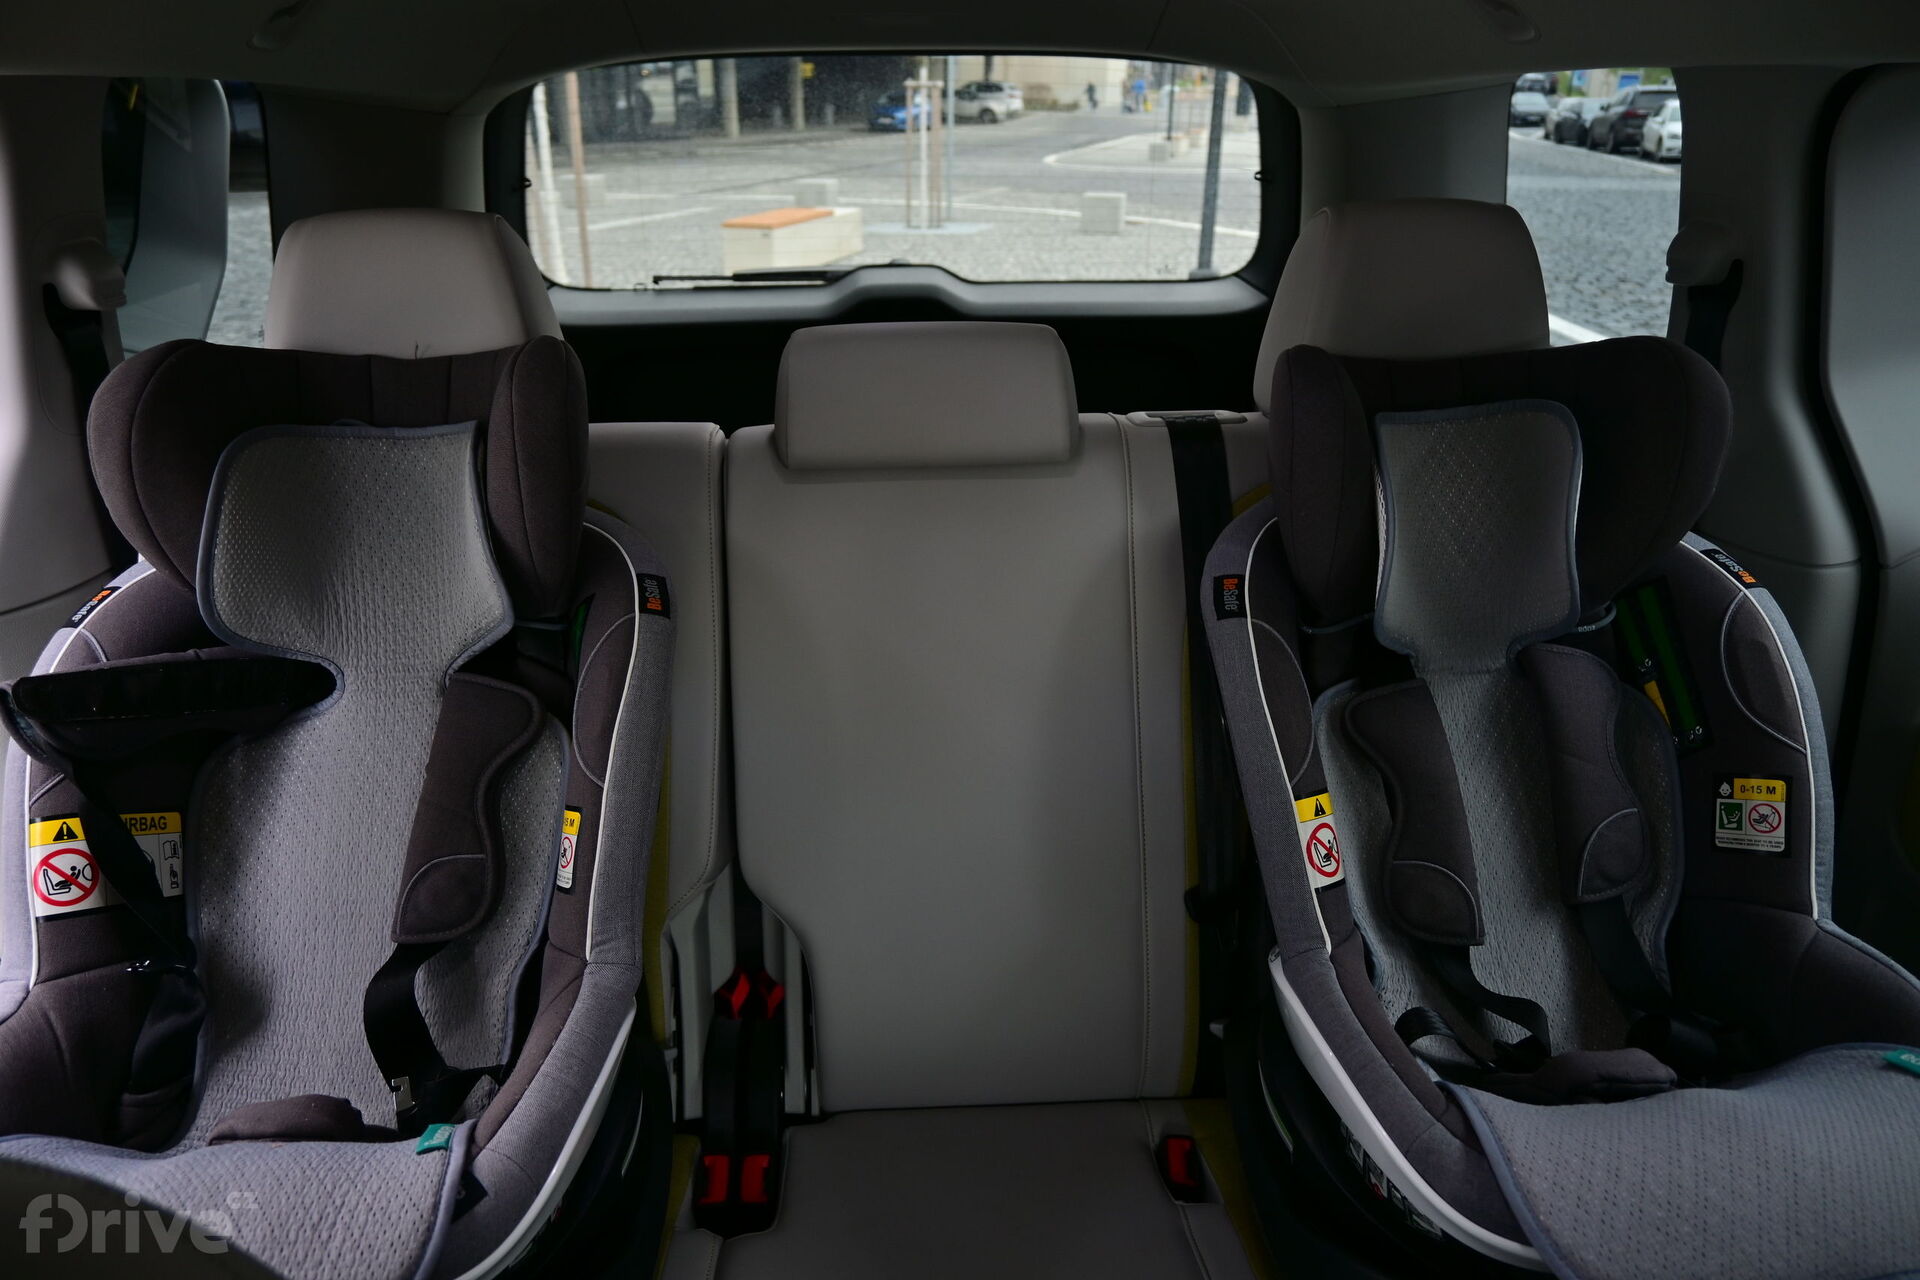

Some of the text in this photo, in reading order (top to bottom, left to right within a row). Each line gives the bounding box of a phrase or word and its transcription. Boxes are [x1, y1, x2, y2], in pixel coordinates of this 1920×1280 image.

[644, 580, 663, 610] BeSafe
[1223, 578, 1239, 610] BeSafe
[1740, 784, 1776, 795] 0-15 M
[124, 816, 167, 832] IRBAG
